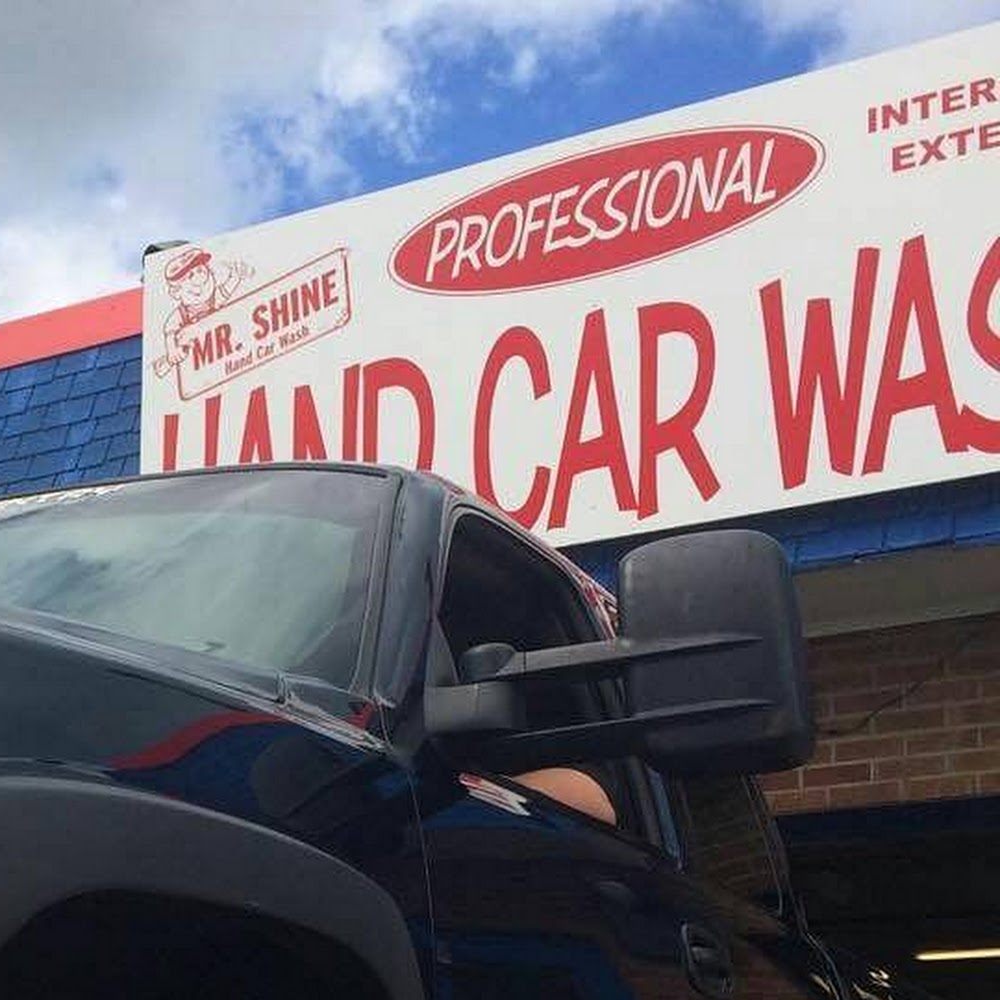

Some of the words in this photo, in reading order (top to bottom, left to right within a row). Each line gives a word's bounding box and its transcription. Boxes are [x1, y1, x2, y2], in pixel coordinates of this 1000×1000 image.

[868, 78, 998, 133] INTER
[892, 121, 1000, 172] EXTE
[426, 139, 777, 282] PROFESSIONAL
[191, 323, 242, 370] MR.
[252, 269, 339, 340] SHINE
[224, 350, 253, 375] Hand
[256, 342, 275, 358] Car
[278, 325, 310, 348] Wash
[473, 301, 721, 531] CAR
